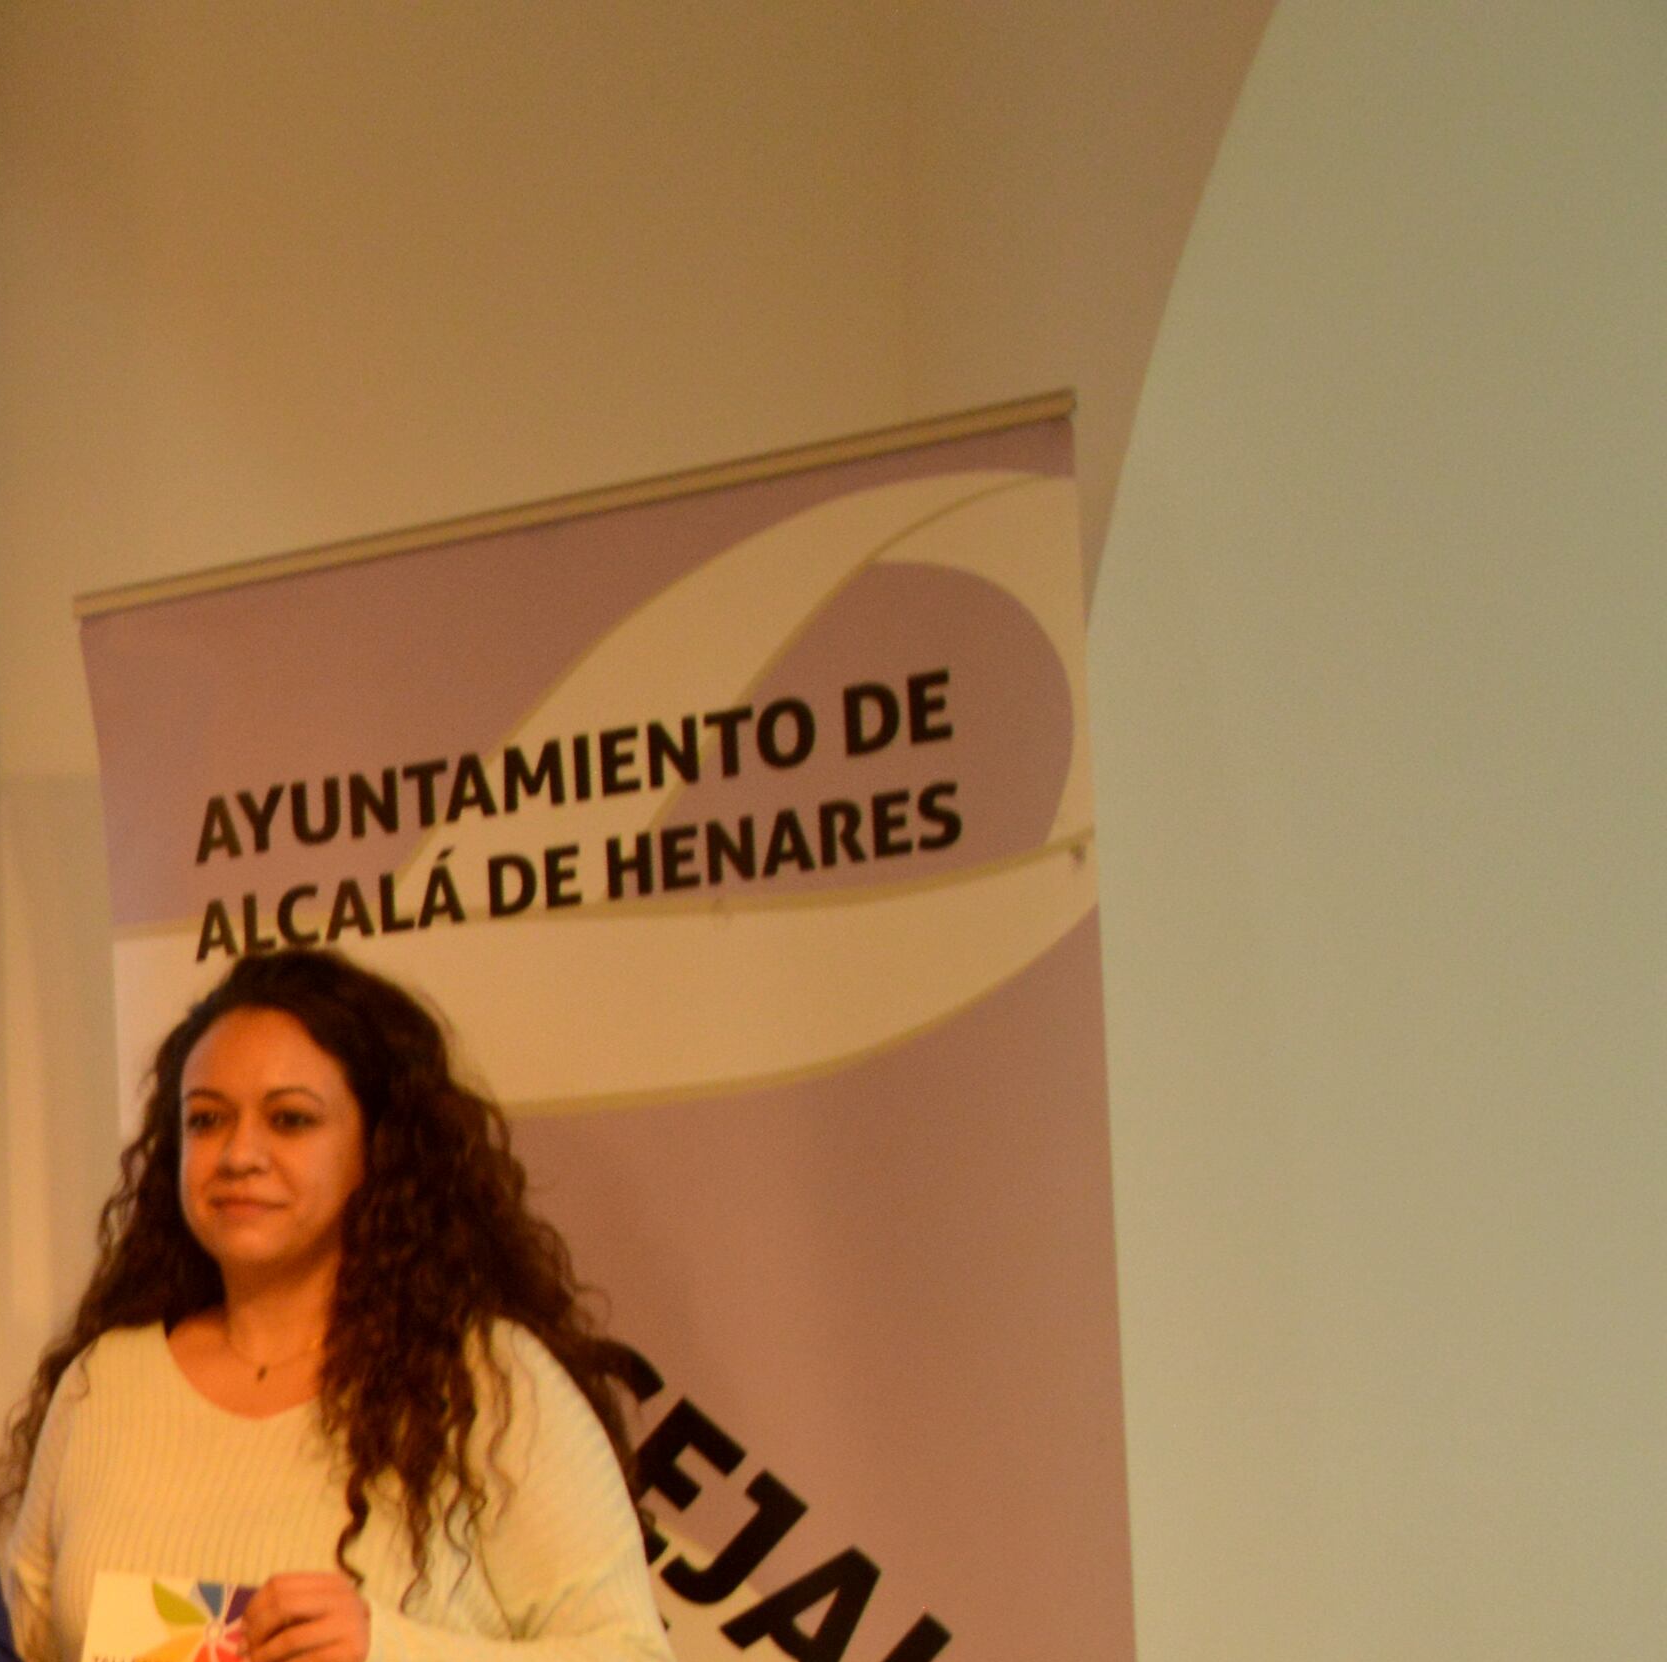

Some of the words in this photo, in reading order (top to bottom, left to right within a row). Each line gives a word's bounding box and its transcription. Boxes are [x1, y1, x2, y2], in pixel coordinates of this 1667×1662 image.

[195, 694, 819, 866] AYUNTAMIENTO
[843, 668, 955, 758] DE
[195, 846, 466, 965] ALCALÁ
[487, 845, 584, 921] DE
[605, 782, 964, 901] HENARES
